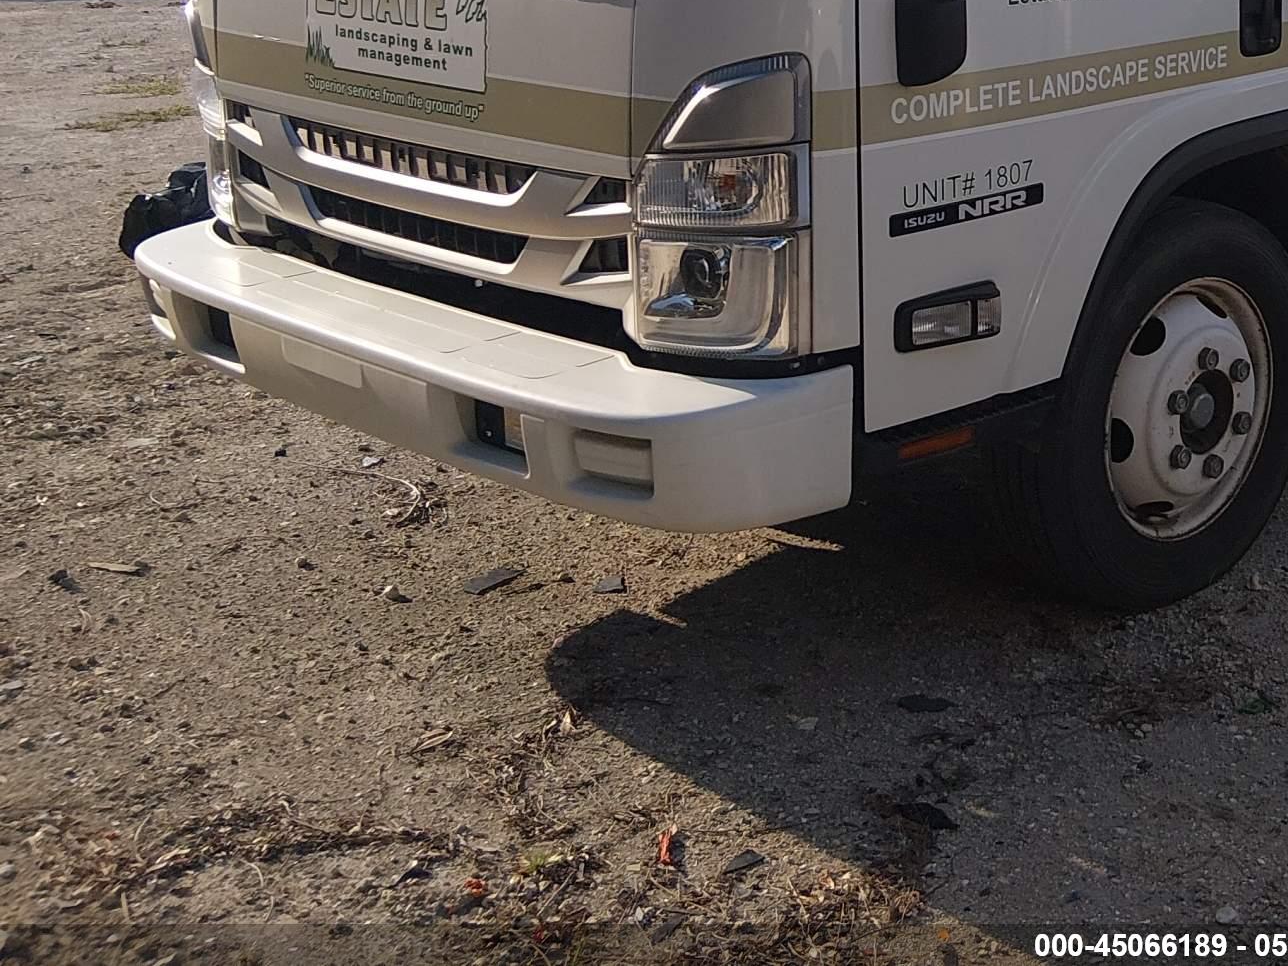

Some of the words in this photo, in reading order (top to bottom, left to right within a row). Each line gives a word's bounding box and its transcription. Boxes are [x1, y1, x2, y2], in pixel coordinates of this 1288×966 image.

[335, 24, 418, 51] landscaping
[423, 37, 434, 51] &
[438, 39, 473, 57] lawn
[357, 46, 448, 71] management
[347, 83, 381, 100] service
[382, 88, 405, 105] from
[407, 91, 423, 108] the
[425, 97, 463, 116] ground
[890, 82, 1022, 125] COMPLETE
[1028, 57, 1149, 103] LANDSCAPE
[1154, 45, 1228, 79] SERVICE
[903, 171, 976, 209] UNIT#
[984, 159, 1033, 191] 1807
[904, 211, 945, 229] ISUZU
[958, 190, 1027, 221] NRR
